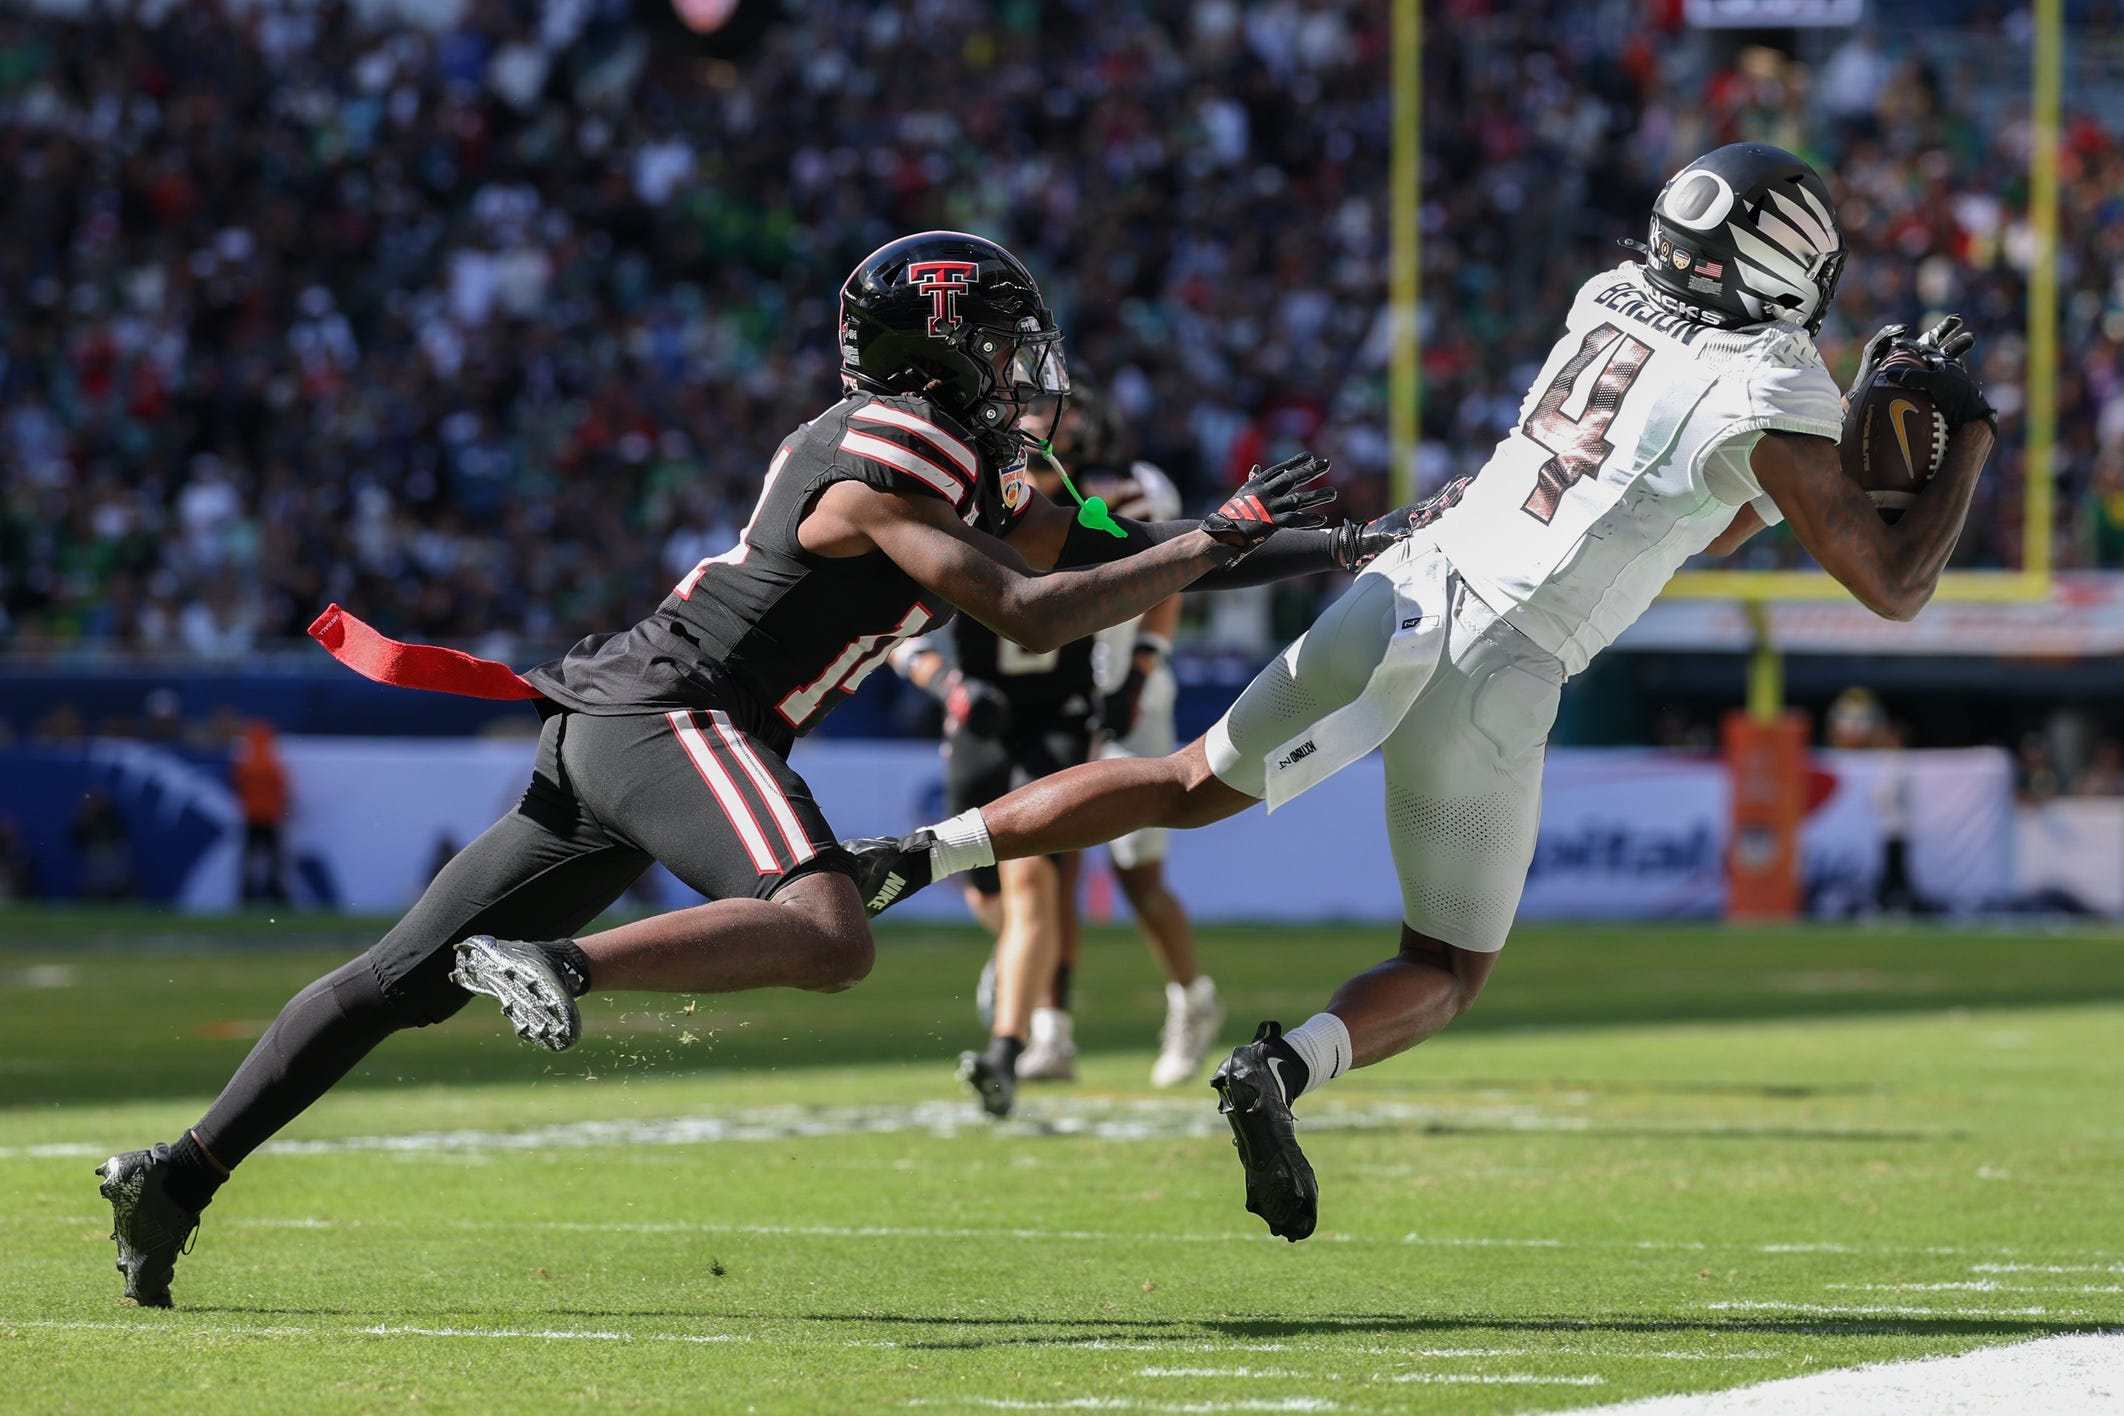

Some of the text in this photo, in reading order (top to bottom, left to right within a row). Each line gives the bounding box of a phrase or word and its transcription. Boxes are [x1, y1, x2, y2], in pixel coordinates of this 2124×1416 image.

[1593, 281, 1708, 346] BENSON
[1649, 285, 1723, 326] UCKS
[1520, 321, 1656, 527] 4
[866, 870, 907, 910] NIKE
